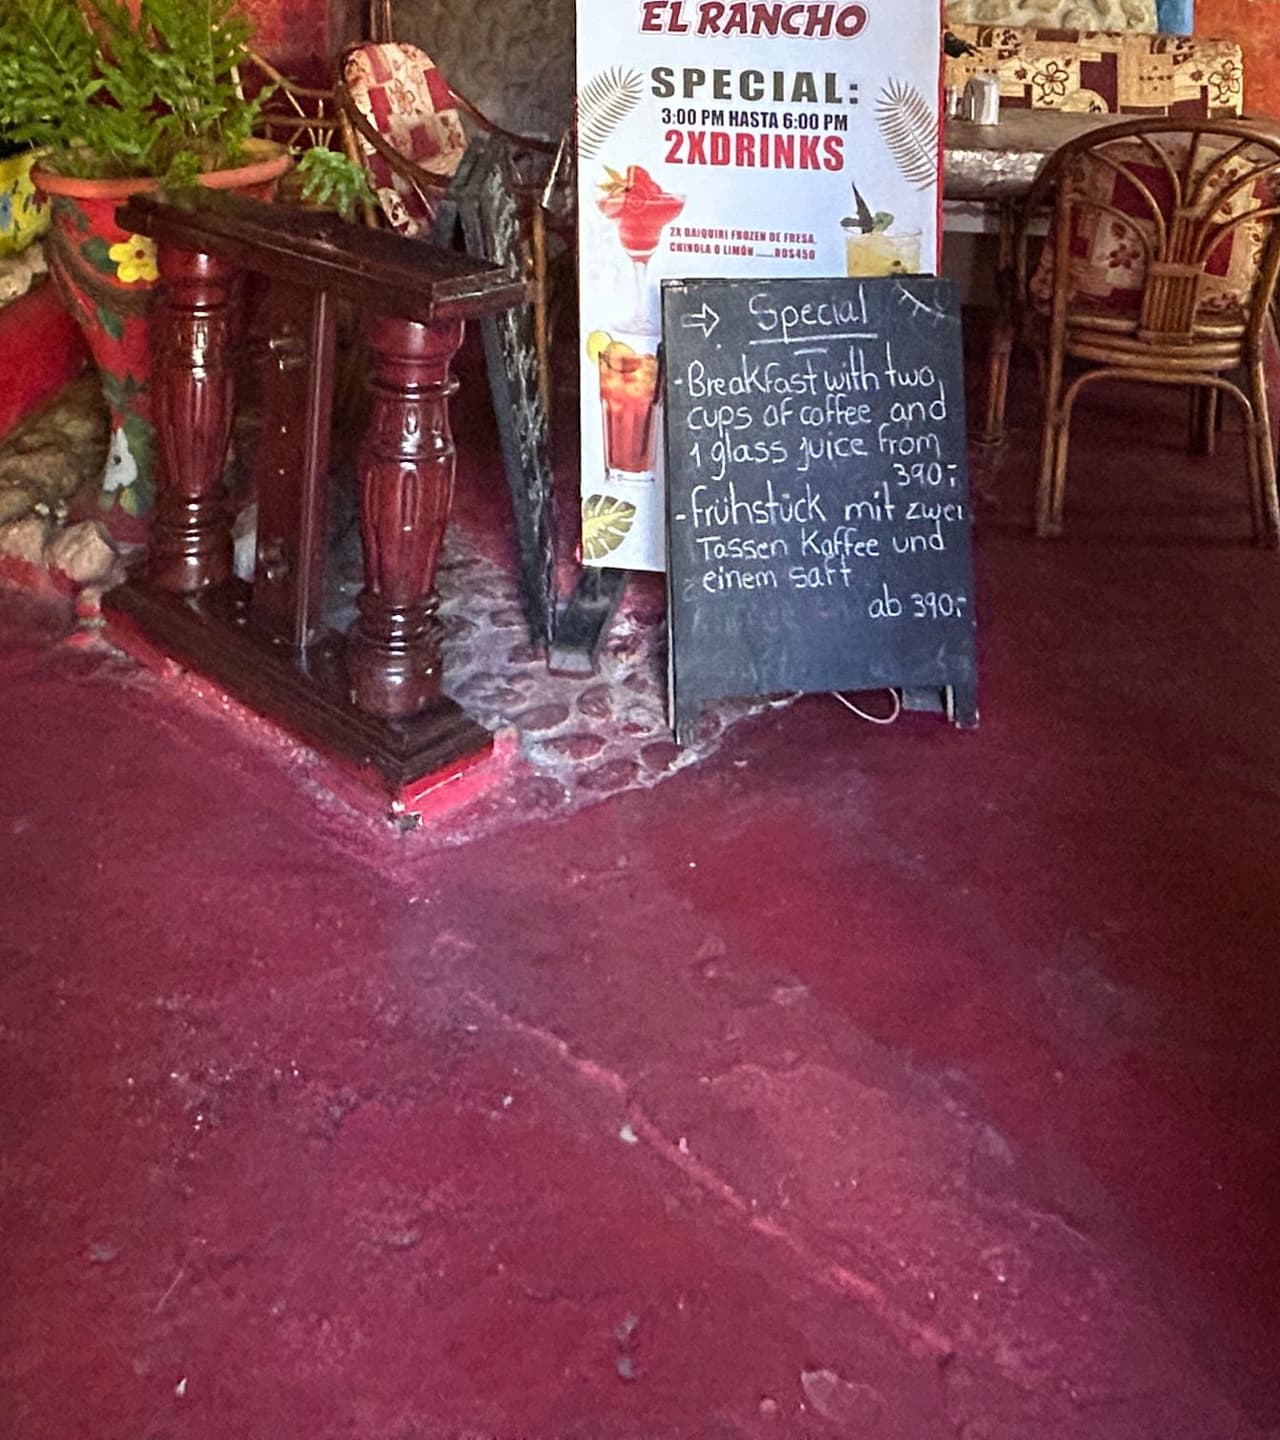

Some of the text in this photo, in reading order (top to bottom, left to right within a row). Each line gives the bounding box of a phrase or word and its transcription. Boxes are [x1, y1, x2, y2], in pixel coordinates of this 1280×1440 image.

[640, 0, 869, 38] EL RANCHO
[651, 67, 859, 105] SPECIAL:
[662, 108, 848, 131] 3:00 PM HASTA 6:00 PM
[664, 129, 845, 171] 2XDRINKS
[670, 226, 682, 238] 2X
[731, 230, 766, 242] FROZEN
[769, 232, 781, 243] DE
[670, 242, 711, 254] CHINOLA
[714, 245, 720, 255] O
[749, 283, 868, 343] Special
[687, 354, 817, 397] Breakfast
[824, 346, 880, 392] with
[687, 381, 946, 437] cups of coffee and
[689, 423, 941, 480] 1 glass juice from
[845, 481, 895, 521] mit
[905, 502, 966, 522] zwei
[696, 520, 946, 561] Tassen Kaffee und
[703, 568, 778, 593] einem
[870, 583, 902, 619] ab
